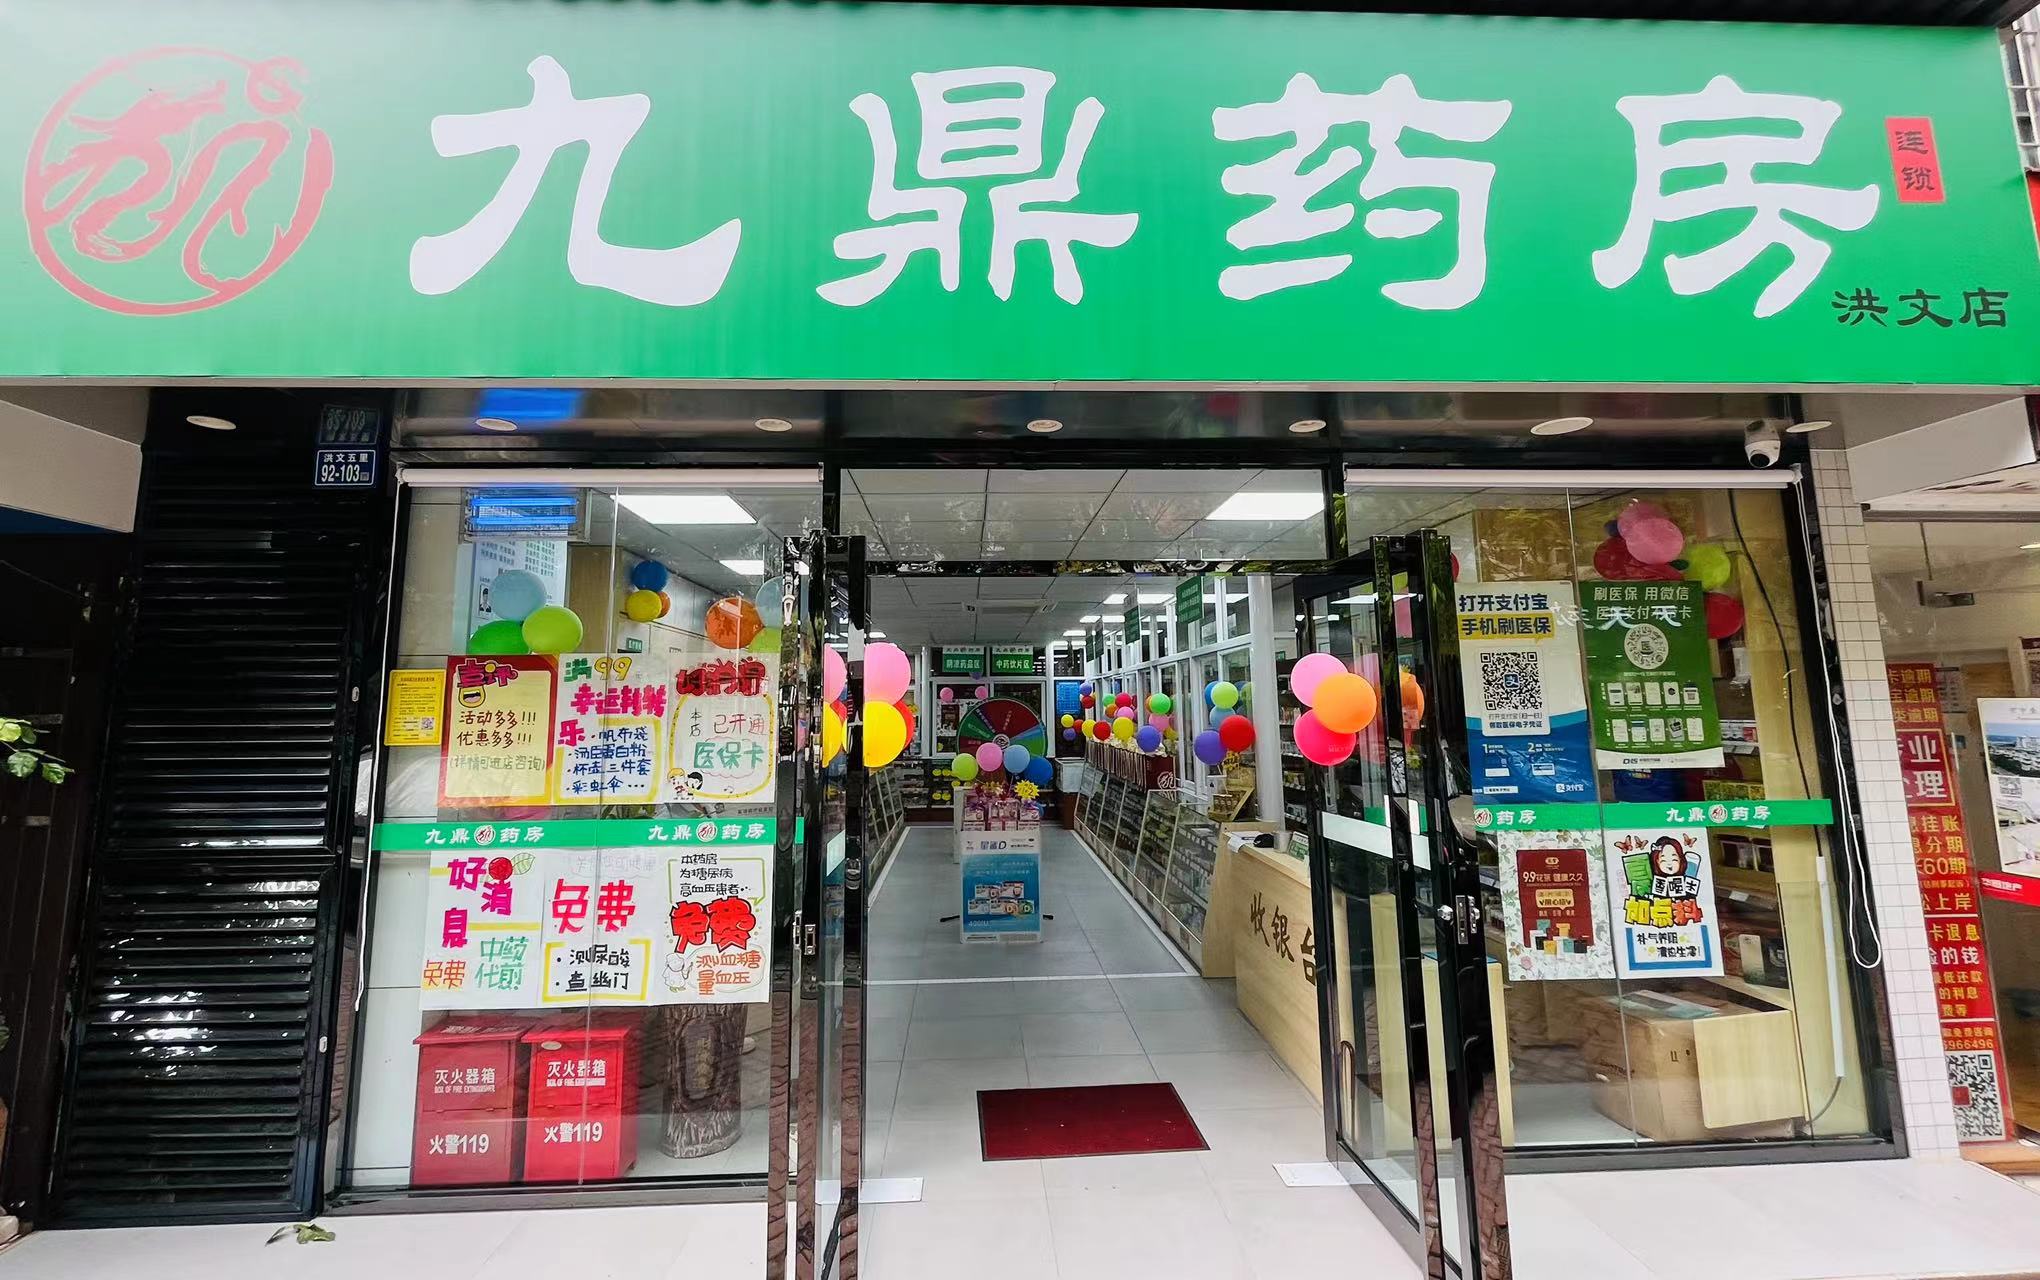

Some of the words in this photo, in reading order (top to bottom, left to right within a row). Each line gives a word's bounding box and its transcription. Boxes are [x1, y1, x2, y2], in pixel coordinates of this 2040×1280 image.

[1896, 130, 1934, 194] 连锁
[410, 55, 1879, 318] 九鼎药房
[1833, 288, 2009, 329] 洪文店
[323, 453, 369, 463] 洪文五里
[1458, 593, 1549, 612] 打开支付宝
[1594, 586, 1638, 601] 刷医保
[1644, 586, 1690, 601] 用微信
[1461, 617, 1552, 635] 手机刷医保
[713, 713, 768, 736] 已开通
[693, 741, 764, 770] 医保卡
[1902, 770, 1948, 798] 理
[1496, 810, 1536, 825] 药房
[1666, 807, 1705, 823] 九鼎
[1731, 806, 1771, 821] 药房
[425, 828, 470, 845] 九鼎
[500, 827, 545, 844] 药房
[648, 824, 692, 841] 九鼎
[722, 822, 766, 840] 药房
[551, 878, 637, 935] 免费
[669, 895, 757, 955] 免费
[480, 937, 529, 962] 中药
[1250, 891, 1317, 987] 收银台
[569, 944, 631, 969] 测尿酸
[696, 949, 762, 969] 测血糖
[423, 959, 467, 990] 免费
[565, 970, 630, 992] 查幽门
[697, 970, 752, 996] 量血压
[434, 1067, 496, 1085] 灭火器箱
[547, 1059, 607, 1077] 灭火器箱
[543, 1122, 603, 1143] 火警119
[429, 1134, 489, 1155] 火警119
